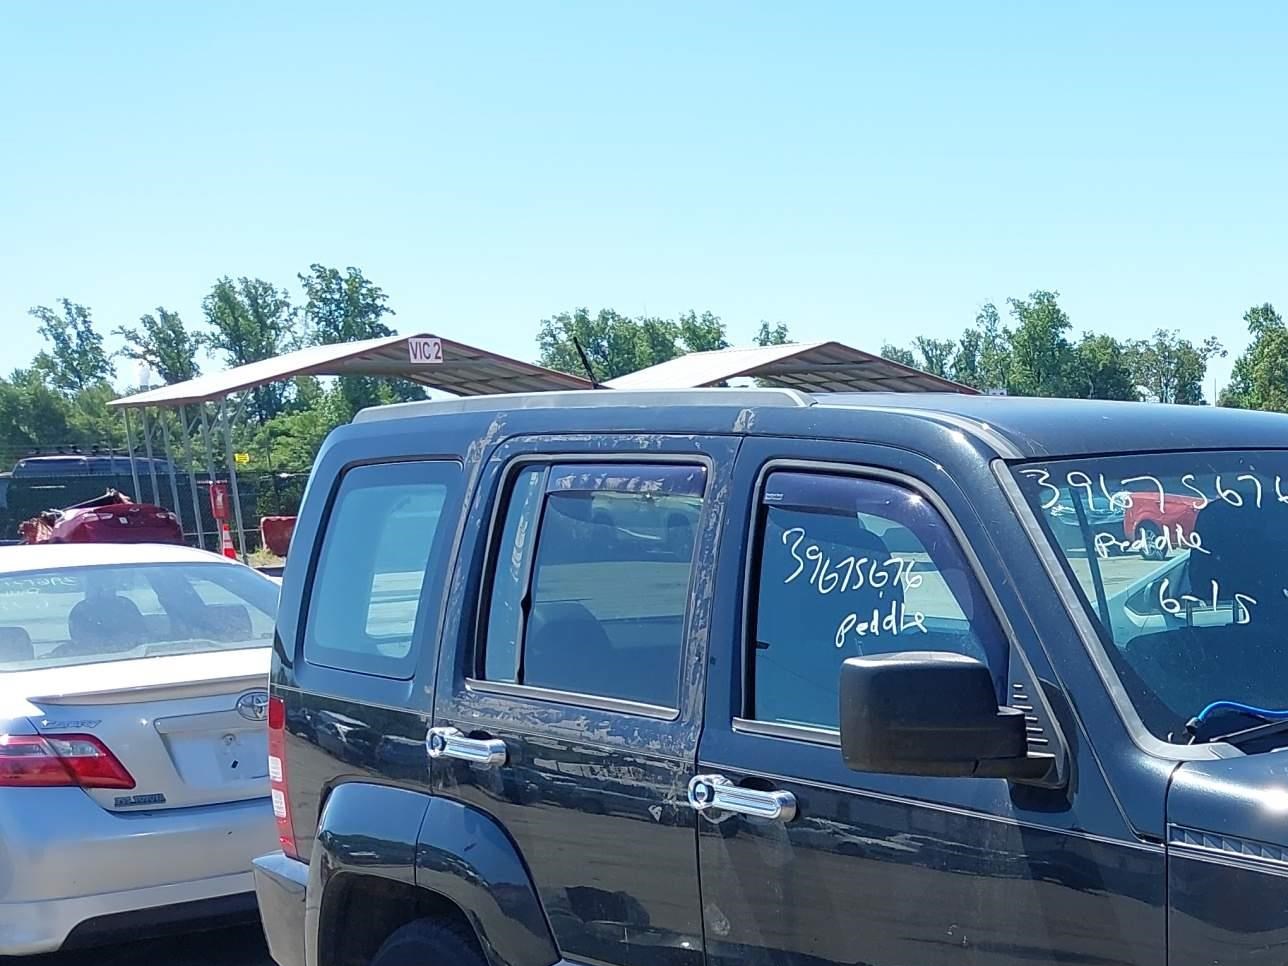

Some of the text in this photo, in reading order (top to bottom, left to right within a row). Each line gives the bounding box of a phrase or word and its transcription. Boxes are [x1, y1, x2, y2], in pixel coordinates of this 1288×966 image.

[409, 341, 442, 360] VIC 2
[781, 527, 924, 594] 39675676
[1159, 578, 1257, 625] 6-15
